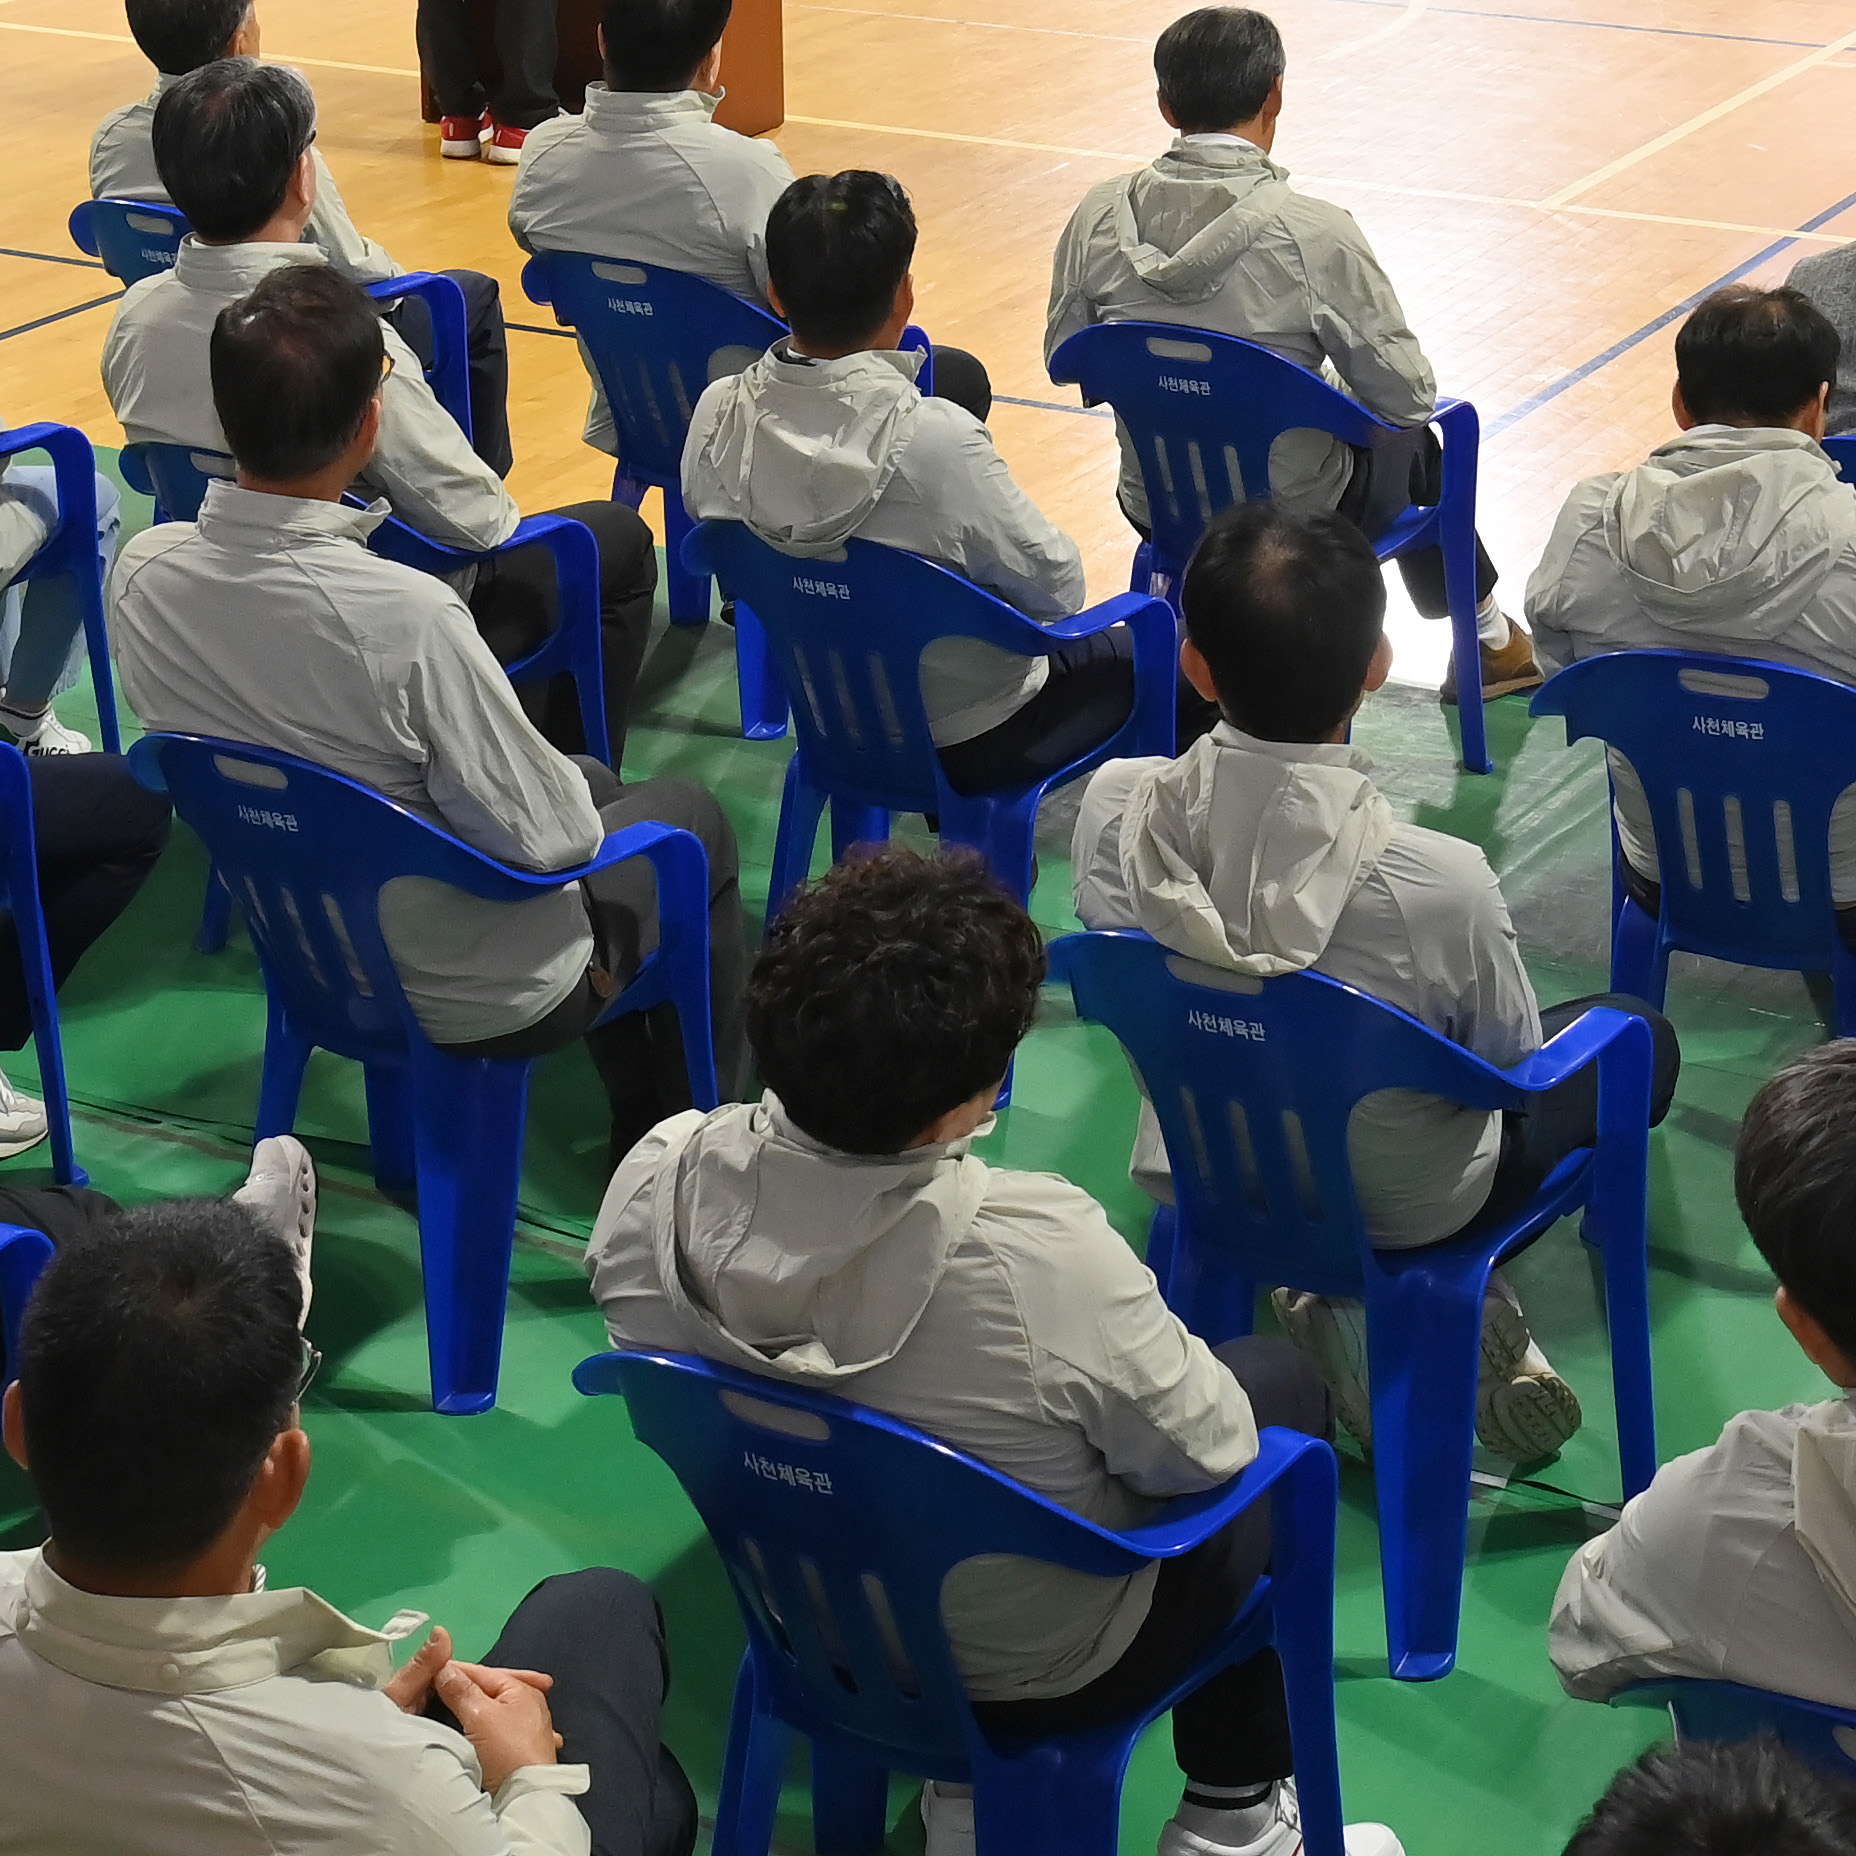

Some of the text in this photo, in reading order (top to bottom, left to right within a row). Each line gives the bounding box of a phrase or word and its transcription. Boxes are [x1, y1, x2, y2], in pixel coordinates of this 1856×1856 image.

[607, 297, 654, 316] 사천체육관
[1158, 375, 1211, 396] 사천체육관
[793, 576, 850, 600] 사천체육관
[1692, 715, 1764, 740] 사천체육관
[237, 804, 299, 832] 사천체육관
[1188, 1009, 1266, 1042] 사천체육관
[743, 1450, 834, 1495] 사천체육관
